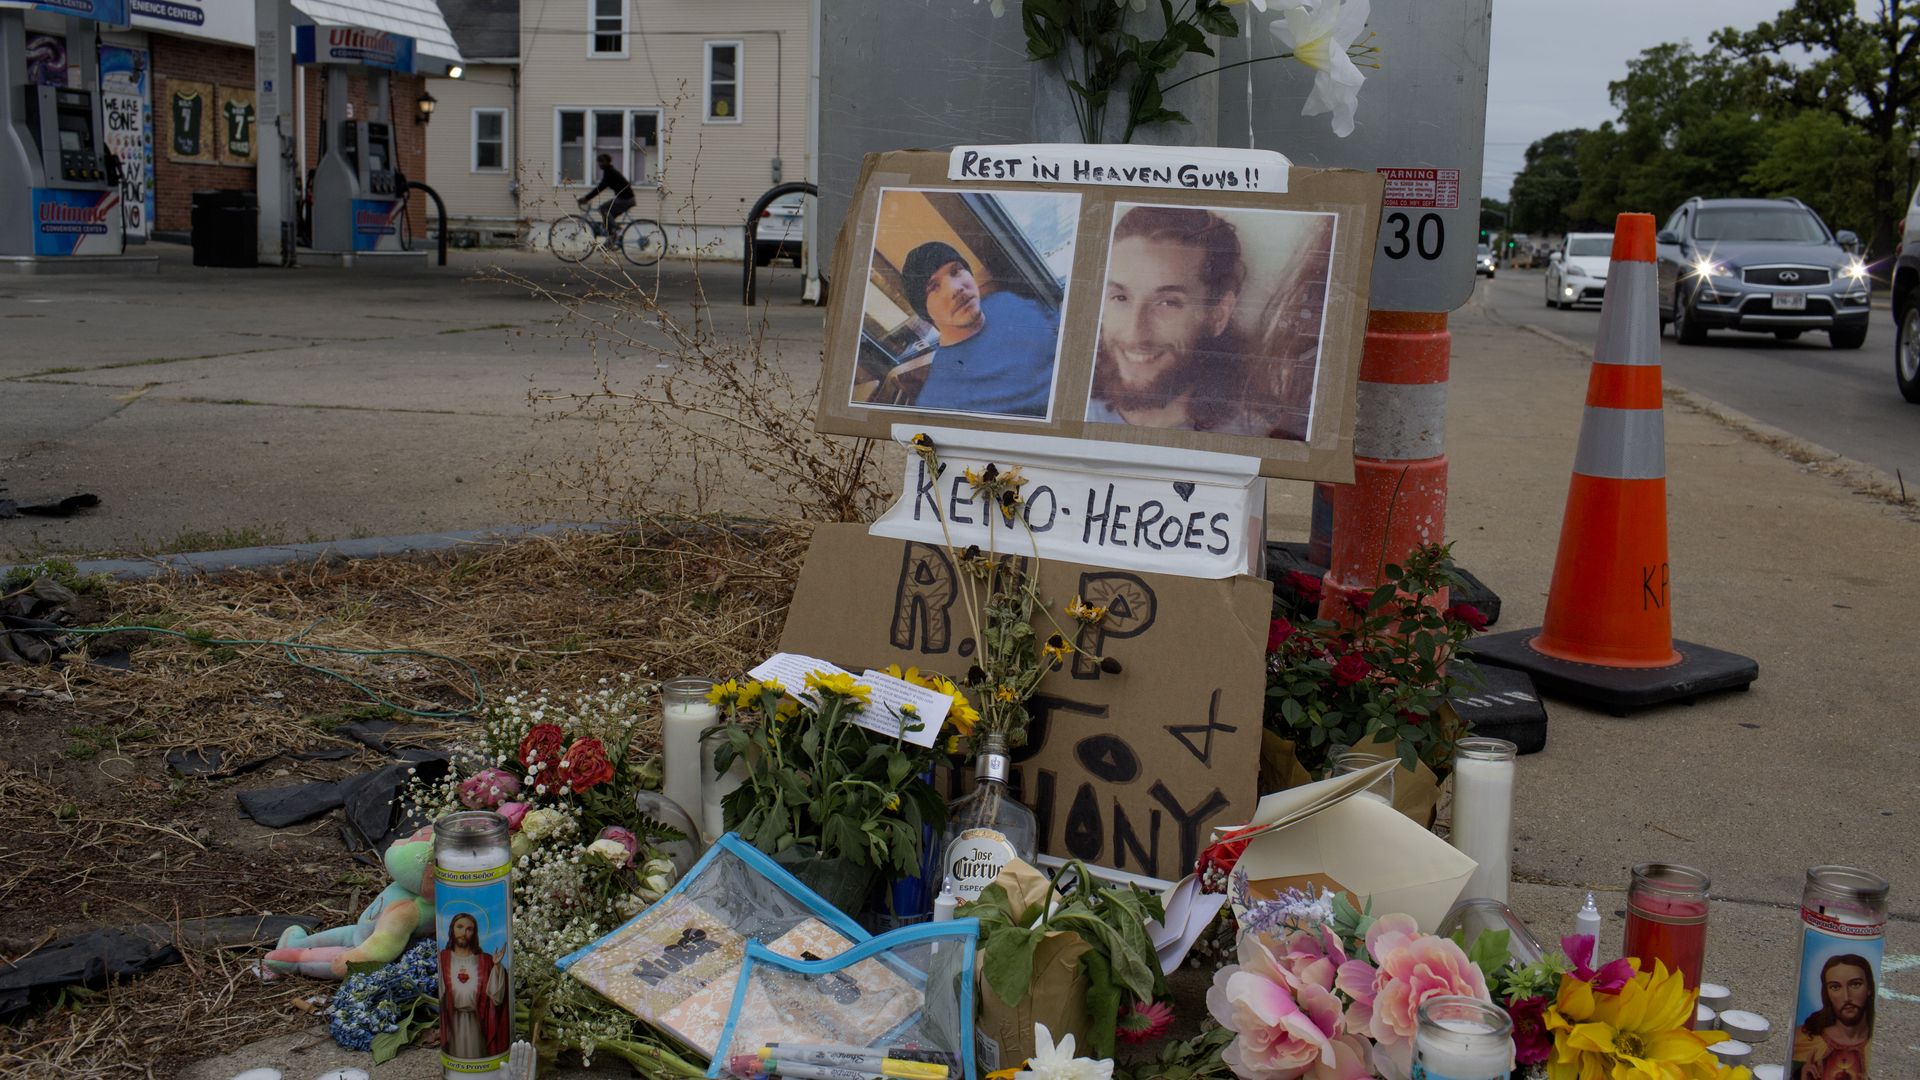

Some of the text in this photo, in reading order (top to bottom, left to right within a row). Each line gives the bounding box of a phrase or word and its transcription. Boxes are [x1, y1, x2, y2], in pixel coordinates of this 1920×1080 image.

[167, 8, 199, 21] CENTER
[105, 98, 139, 113] WE ARE
[108, 111, 139, 132] ONE
[961, 150, 1022, 179] REST
[1073, 159, 1172, 184] HEAVEN
[1380, 169, 1434, 179] WARNING
[1384, 212, 1445, 260] 30
[1083, 482, 1230, 556] HEROES
[972, 847, 993, 862] Jose
[1807, 915, 1838, 930] Sagrado
[1839, 925, 1873, 934] Corazón
